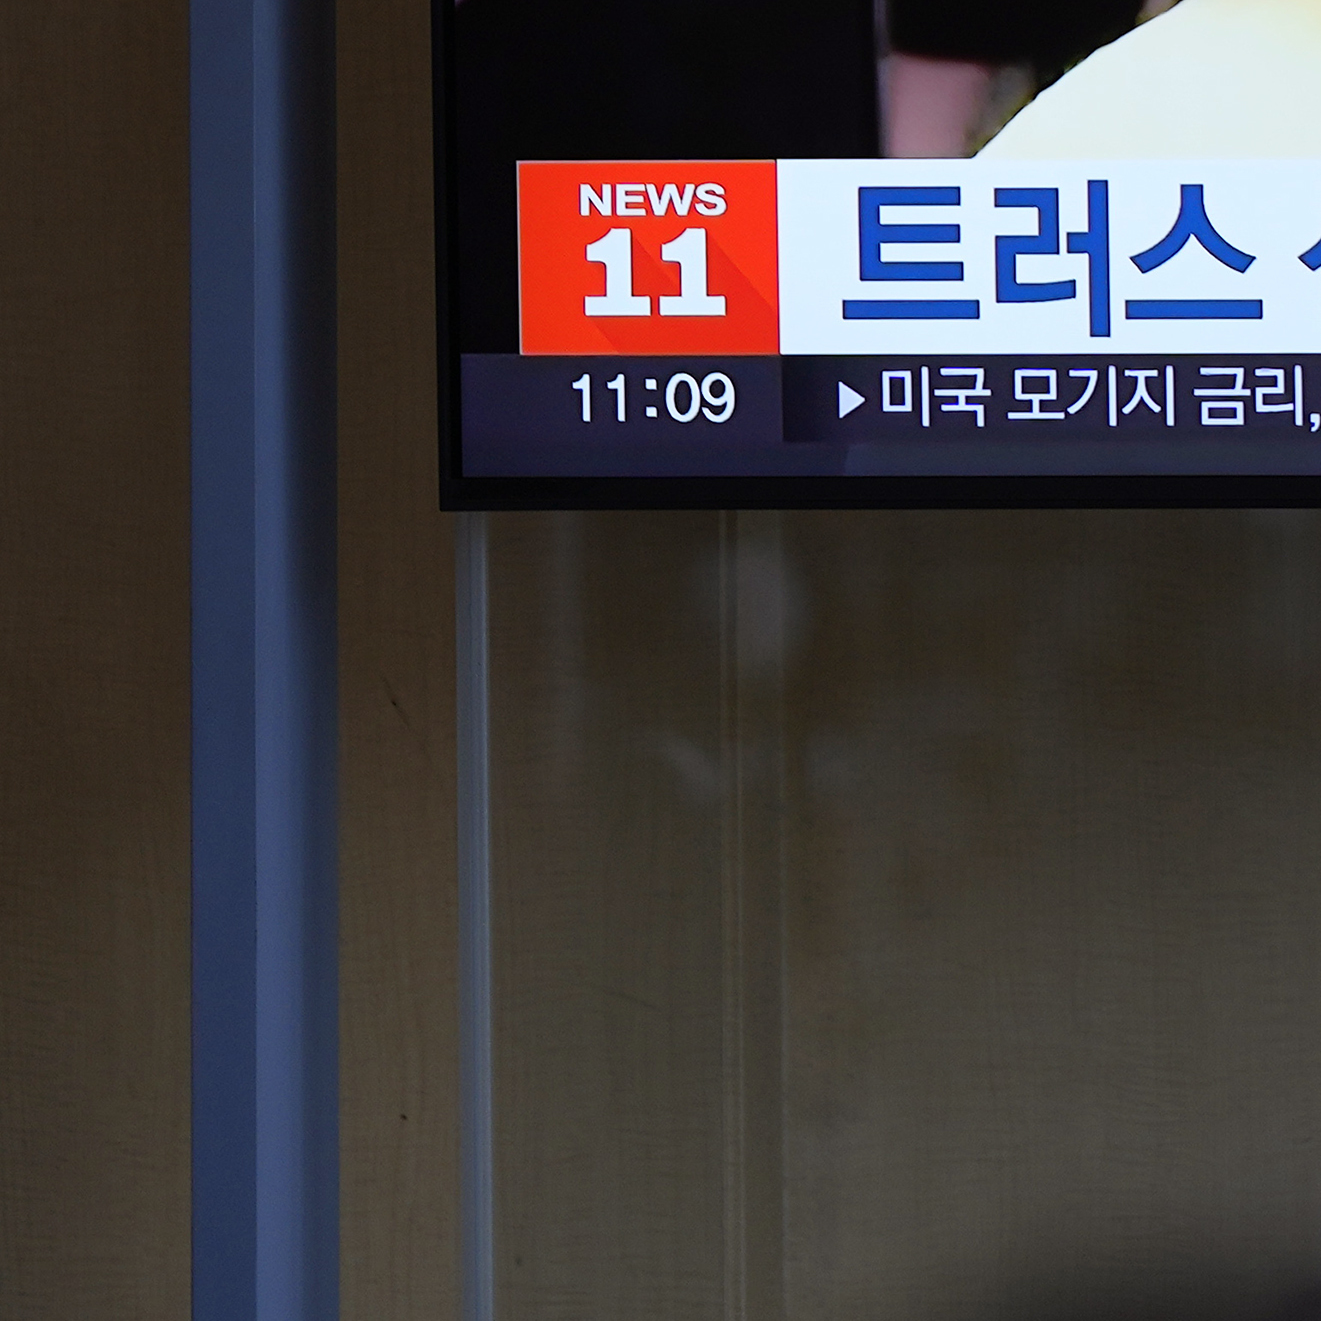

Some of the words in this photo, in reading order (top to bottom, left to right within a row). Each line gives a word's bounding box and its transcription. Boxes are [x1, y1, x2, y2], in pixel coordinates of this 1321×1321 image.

[580, 182, 727, 217] NEWS
[584, 227, 726, 317] 11
[841, 178, 1264, 338] 트러스
[572, 372, 735, 423] 11:09
[881, 365, 992, 427] 미국
[1007, 365, 1176, 427] 모기지
[1193, 365, 1321, 432] 금리,
